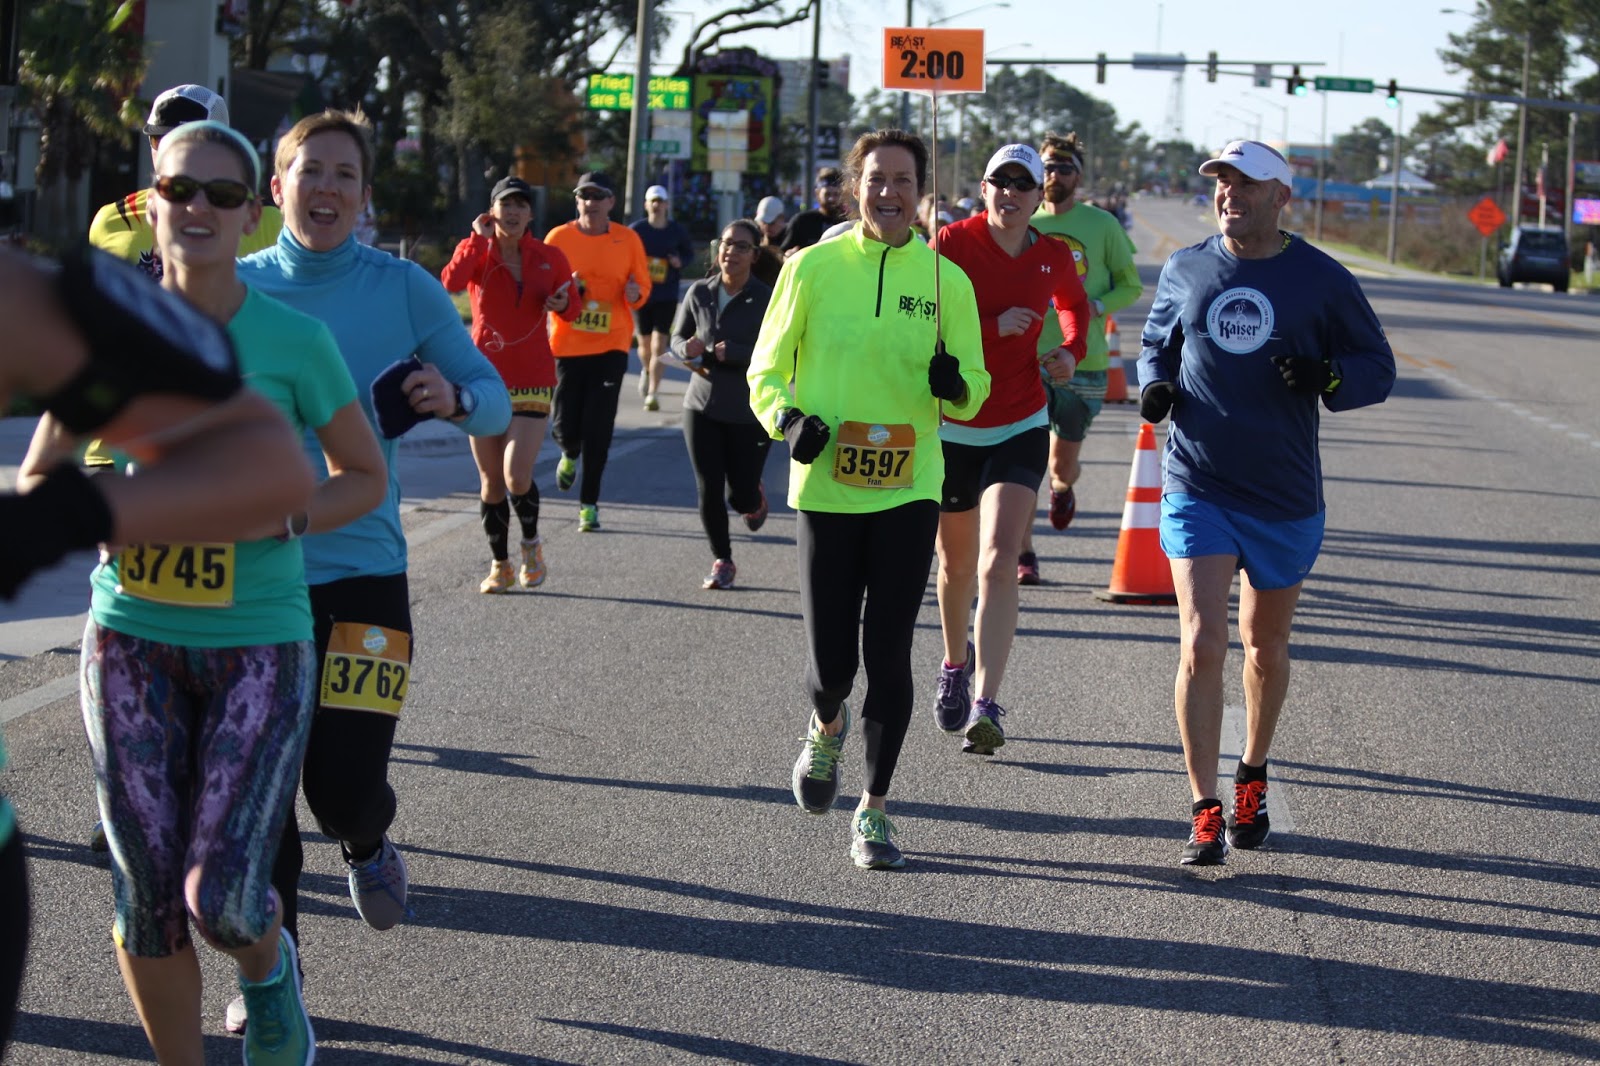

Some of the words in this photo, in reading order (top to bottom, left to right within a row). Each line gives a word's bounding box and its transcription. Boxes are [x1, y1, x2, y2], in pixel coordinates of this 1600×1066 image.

[890, 35, 925, 48] BEAST
[901, 50, 964, 79] 2:00
[590, 75, 632, 91] Fried
[590, 93, 616, 108] are
[899, 295, 937, 318] BEAST
[1220, 320, 1260, 340] Kaiser
[840, 447, 910, 478] 3597
[867, 478, 882, 486] Fran
[127, 544, 226, 590] 3745
[330, 656, 406, 702] 3762
